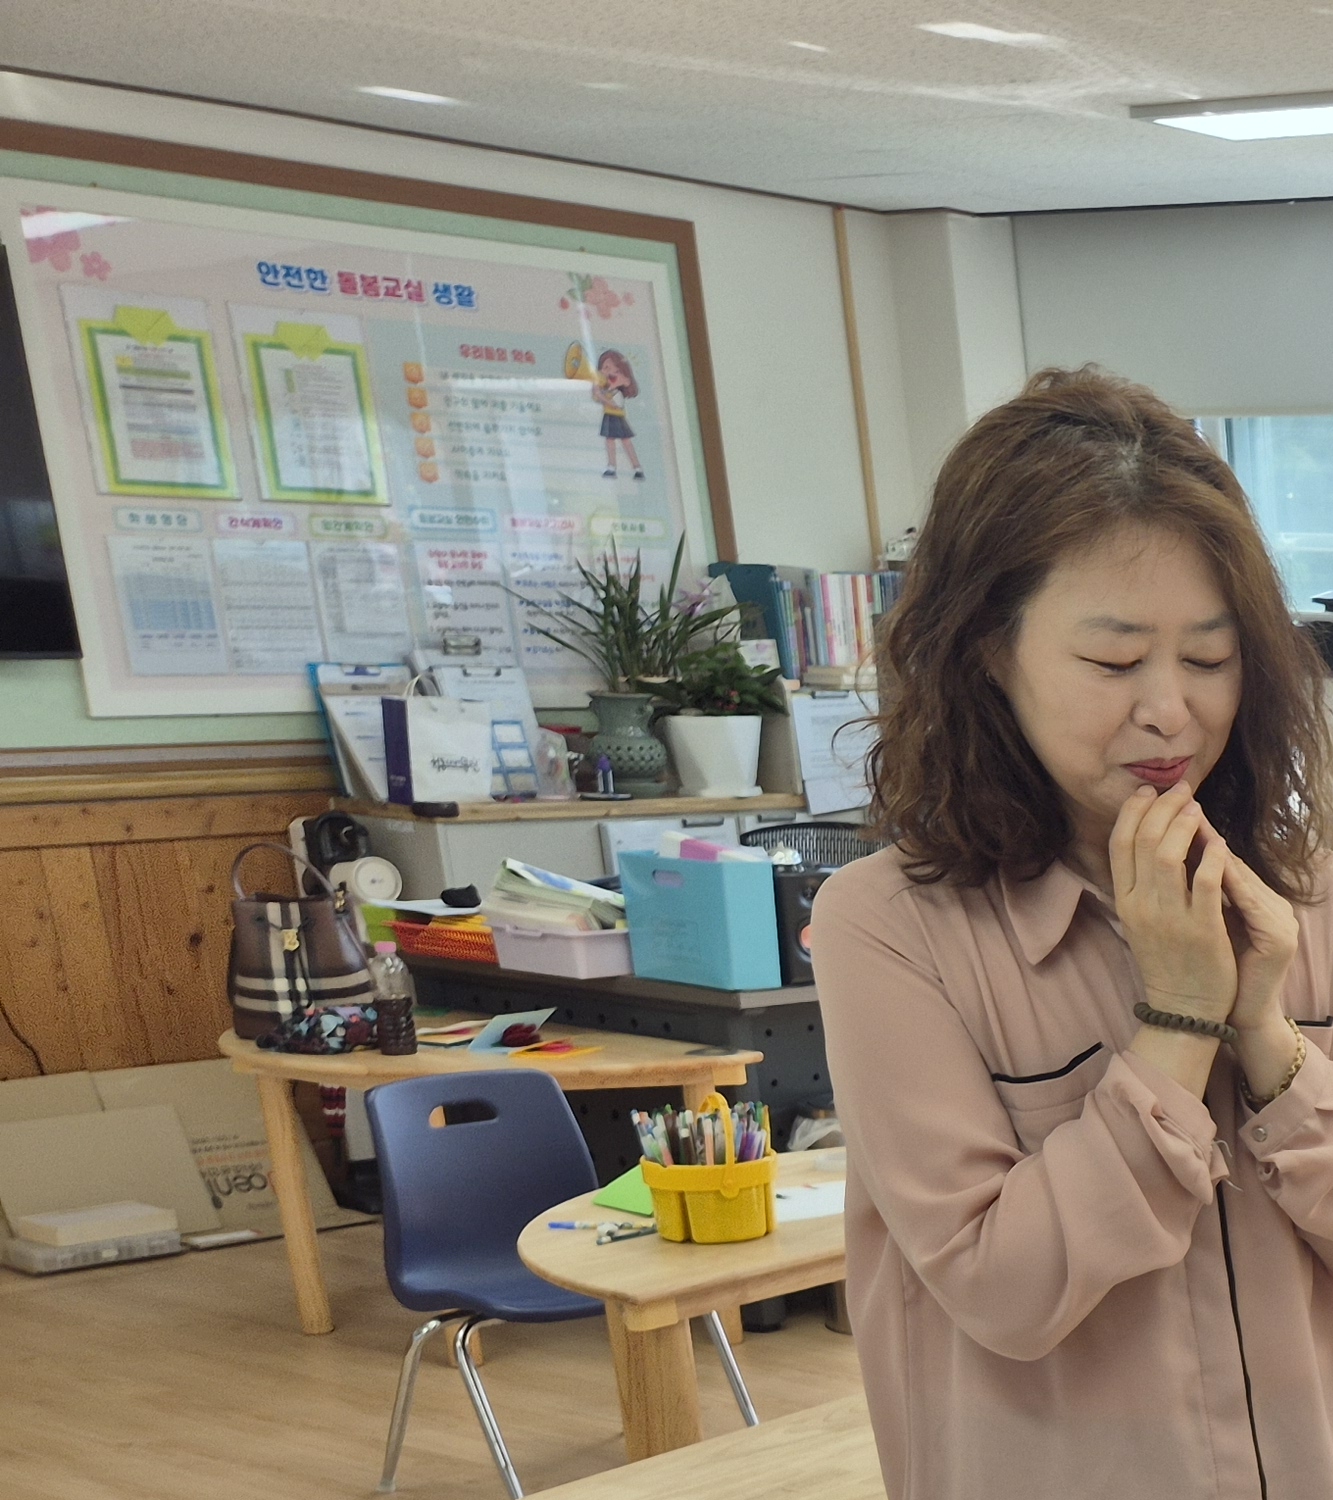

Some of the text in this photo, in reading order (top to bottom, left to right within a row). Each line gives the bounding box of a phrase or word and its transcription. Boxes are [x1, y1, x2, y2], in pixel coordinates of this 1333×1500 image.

[256, 260, 477, 309] 안전한 돌봄교실 생활
